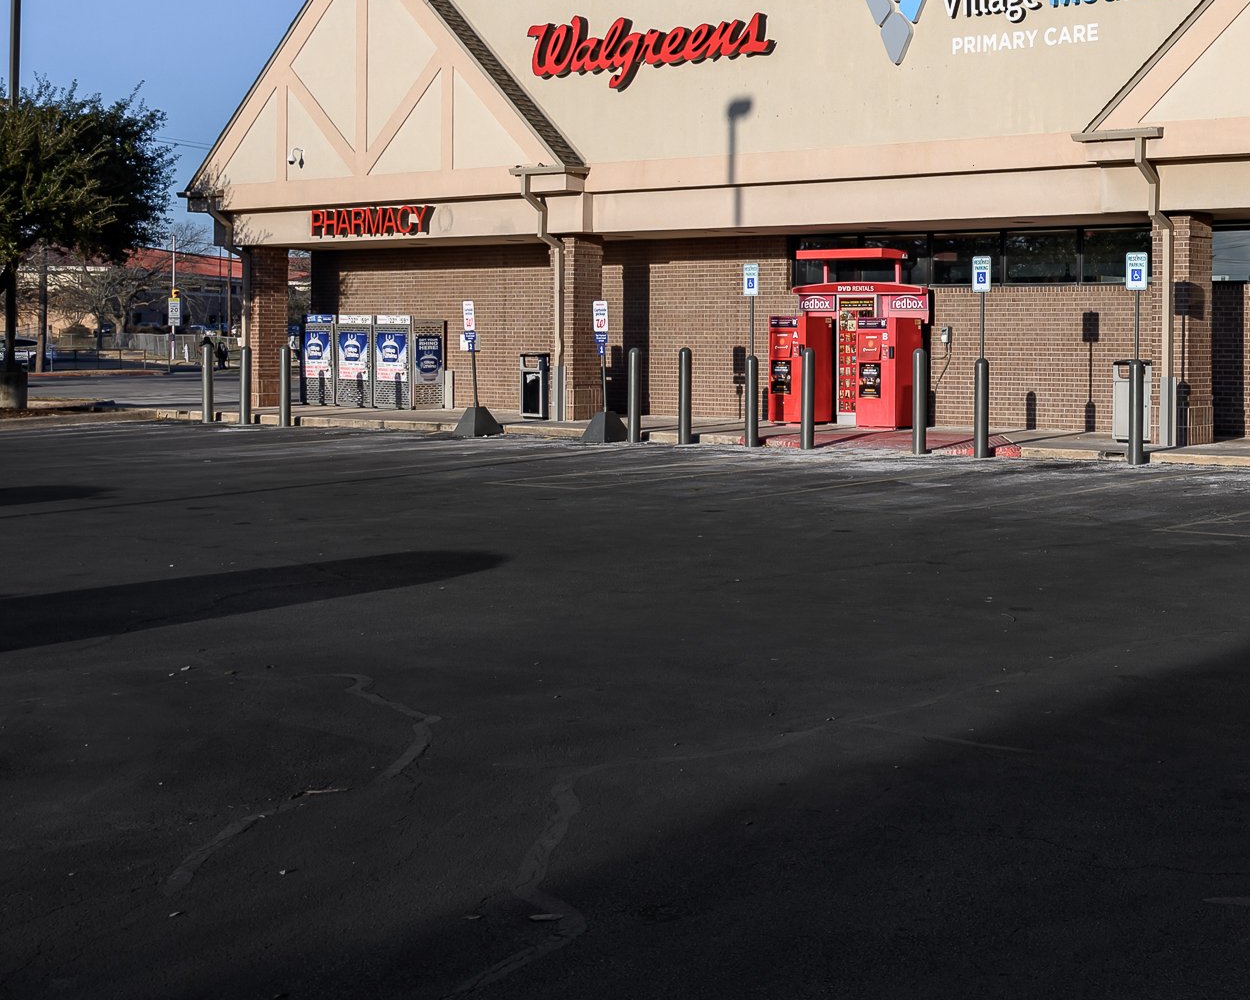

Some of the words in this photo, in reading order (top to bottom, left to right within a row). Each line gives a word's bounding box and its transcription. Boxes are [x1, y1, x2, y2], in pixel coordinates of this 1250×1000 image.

[951, 29, 1038, 55] PRIMARY
[1043, 23, 1099, 47] CARE
[527, 13, 774, 90] Walgreens
[311, 205, 429, 237] PHARMACY
[801, 299, 830, 309] redbox
[892, 298, 923, 308] redbox
[792, 331, 799, 339] A
[882, 332, 889, 341] B
